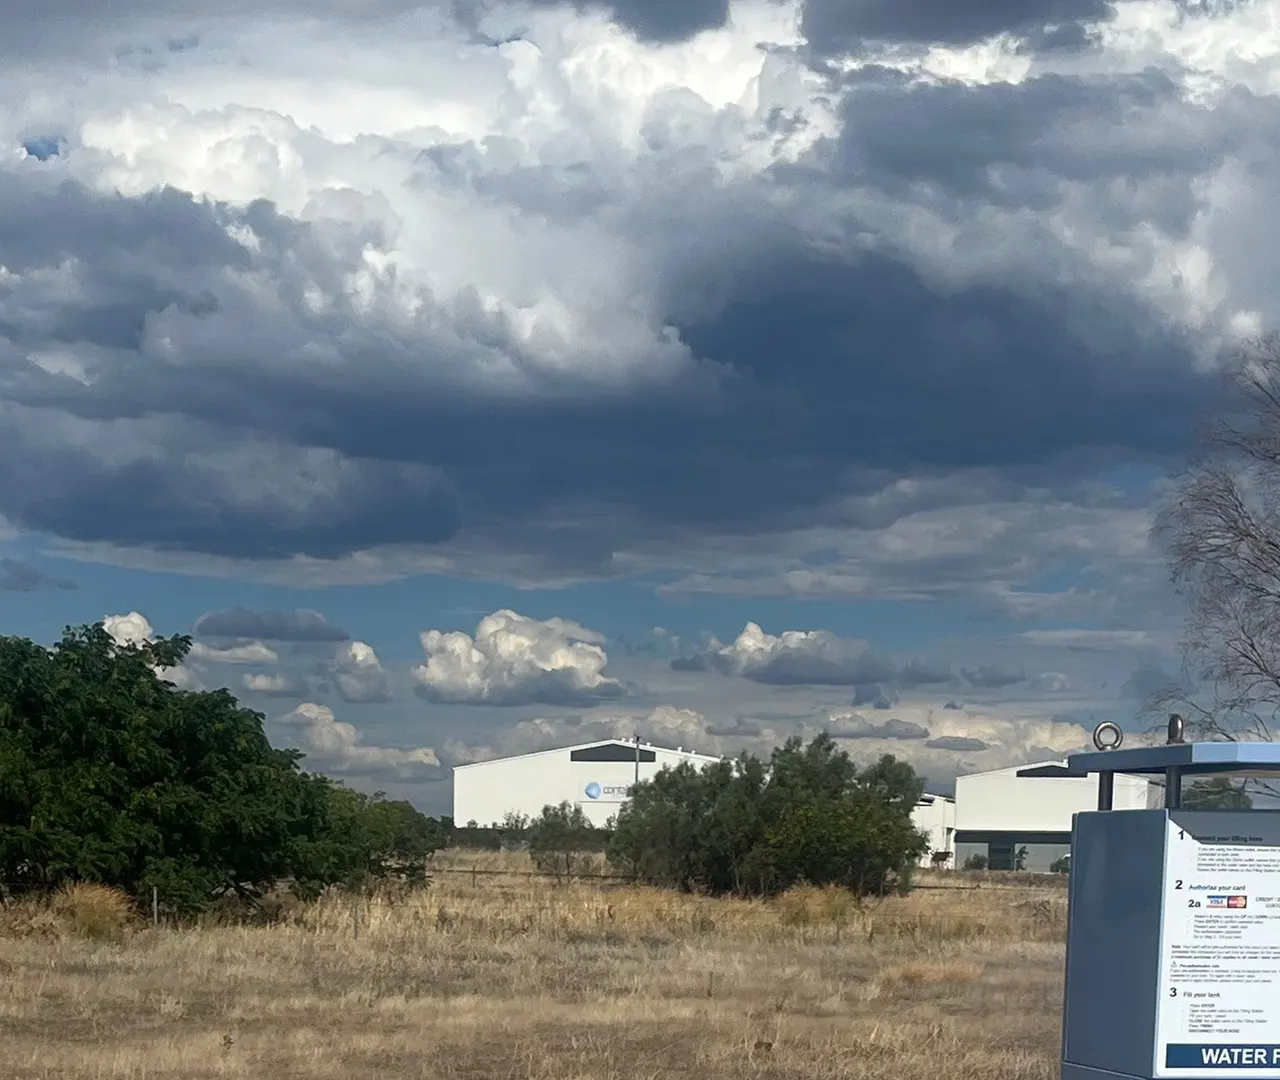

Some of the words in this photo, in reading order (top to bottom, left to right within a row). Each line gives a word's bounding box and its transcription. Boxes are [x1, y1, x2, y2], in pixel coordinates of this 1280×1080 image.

[1178, 829, 1184, 840] 1
[1175, 880, 1183, 890] 2
[1188, 899, 1201, 908] 2a
[1169, 987, 1177, 997] 3
[1201, 1048, 1267, 1064] WATER
